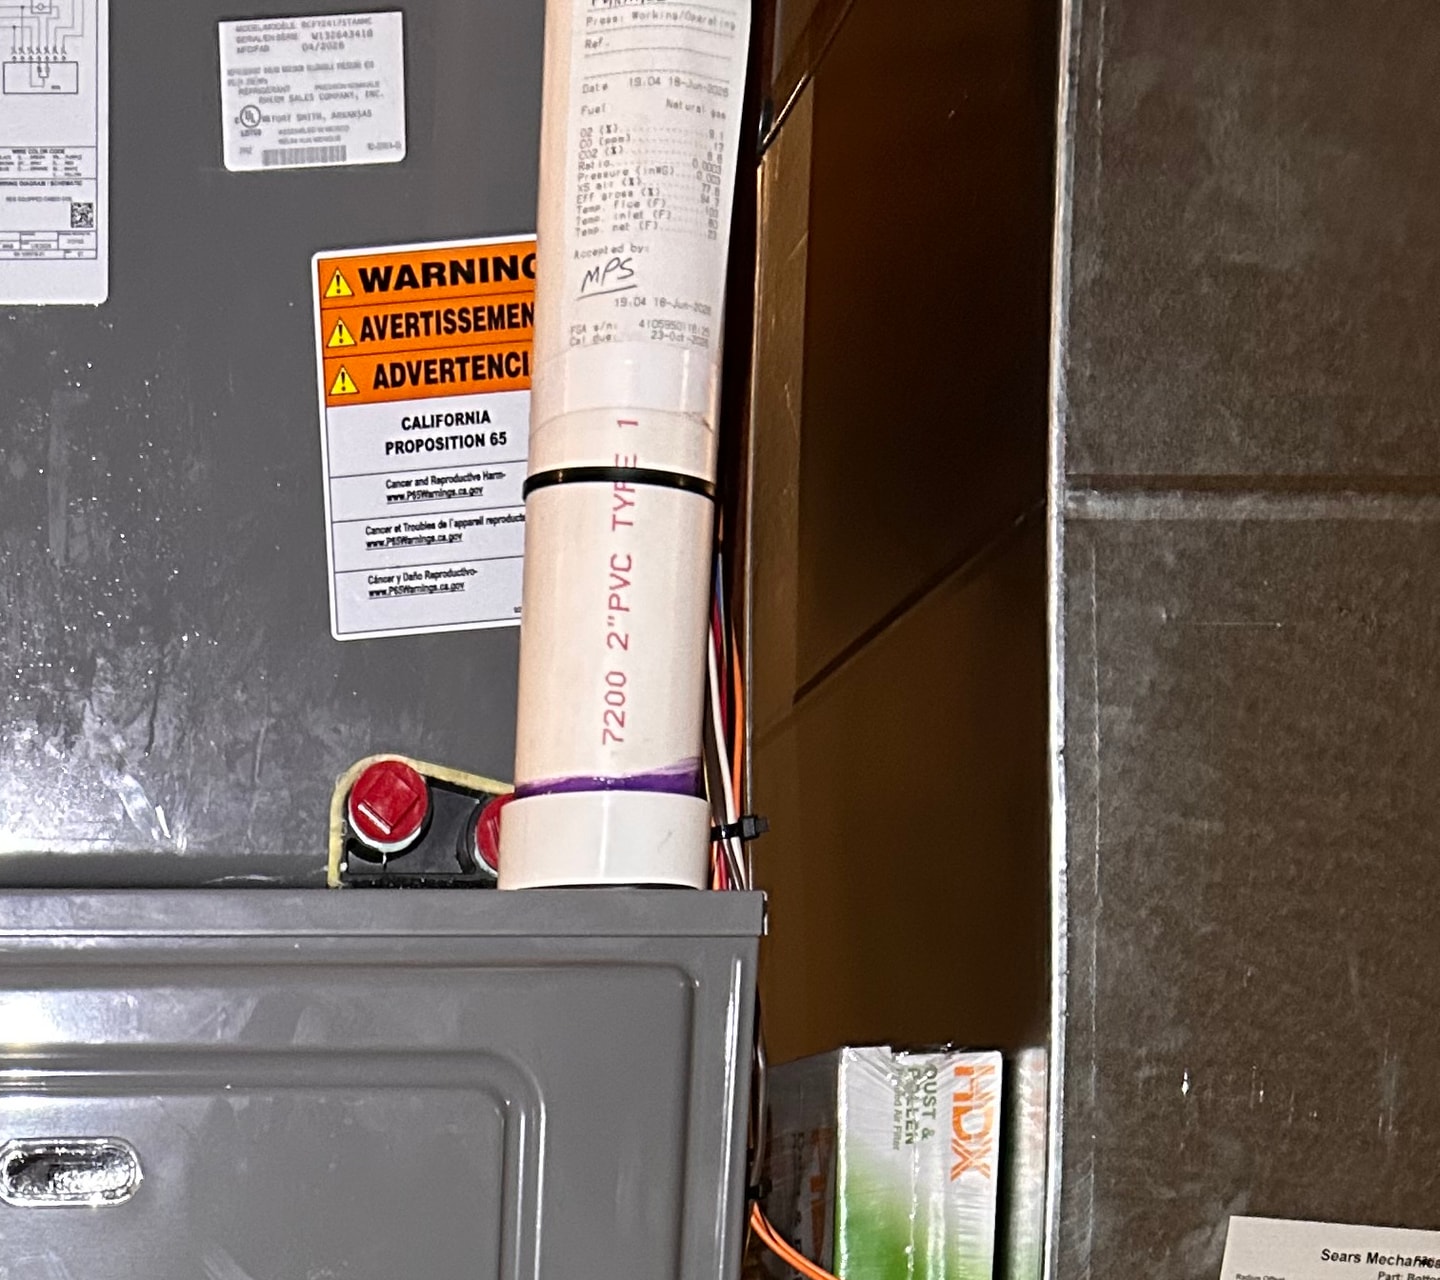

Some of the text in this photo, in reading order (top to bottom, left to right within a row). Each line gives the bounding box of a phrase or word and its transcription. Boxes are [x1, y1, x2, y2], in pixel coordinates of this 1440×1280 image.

[574, 245, 625, 259] Accepted
[581, 257, 635, 293] MPS
[360, 303, 534, 342] AVERTISSEMEN
[373, 352, 529, 389] ADVERTENCI
[401, 410, 491, 430] CALIFORNIA
[385, 432, 506, 455] PROPOSITION 65
[386, 479, 411, 489] Cancer
[415, 476, 429, 486] and
[431, 472, 481, 484] Reproductive
[386, 486, 483, 504] www.P65Warnings.ca.gov
[365, 525, 392, 535] Cancer
[394, 524, 401, 532] et
[404, 521, 435, 531] Troubles
[438, 519, 447, 529] de
[366, 533, 463, 550] www.P65Warnings.ca.gov
[368, 575, 394, 585] Cáncer
[396, 575, 401, 585] y
[403, 571, 422, 580] Daño
[369, 582, 465, 599] www.P65Warnings.ca.gov
[602, 670, 627, 746] 7200
[922, 1064, 938, 1140] DUST &
[951, 1064, 996, 1182] HDX
[1321, 1248, 1361, 1265] Sears
